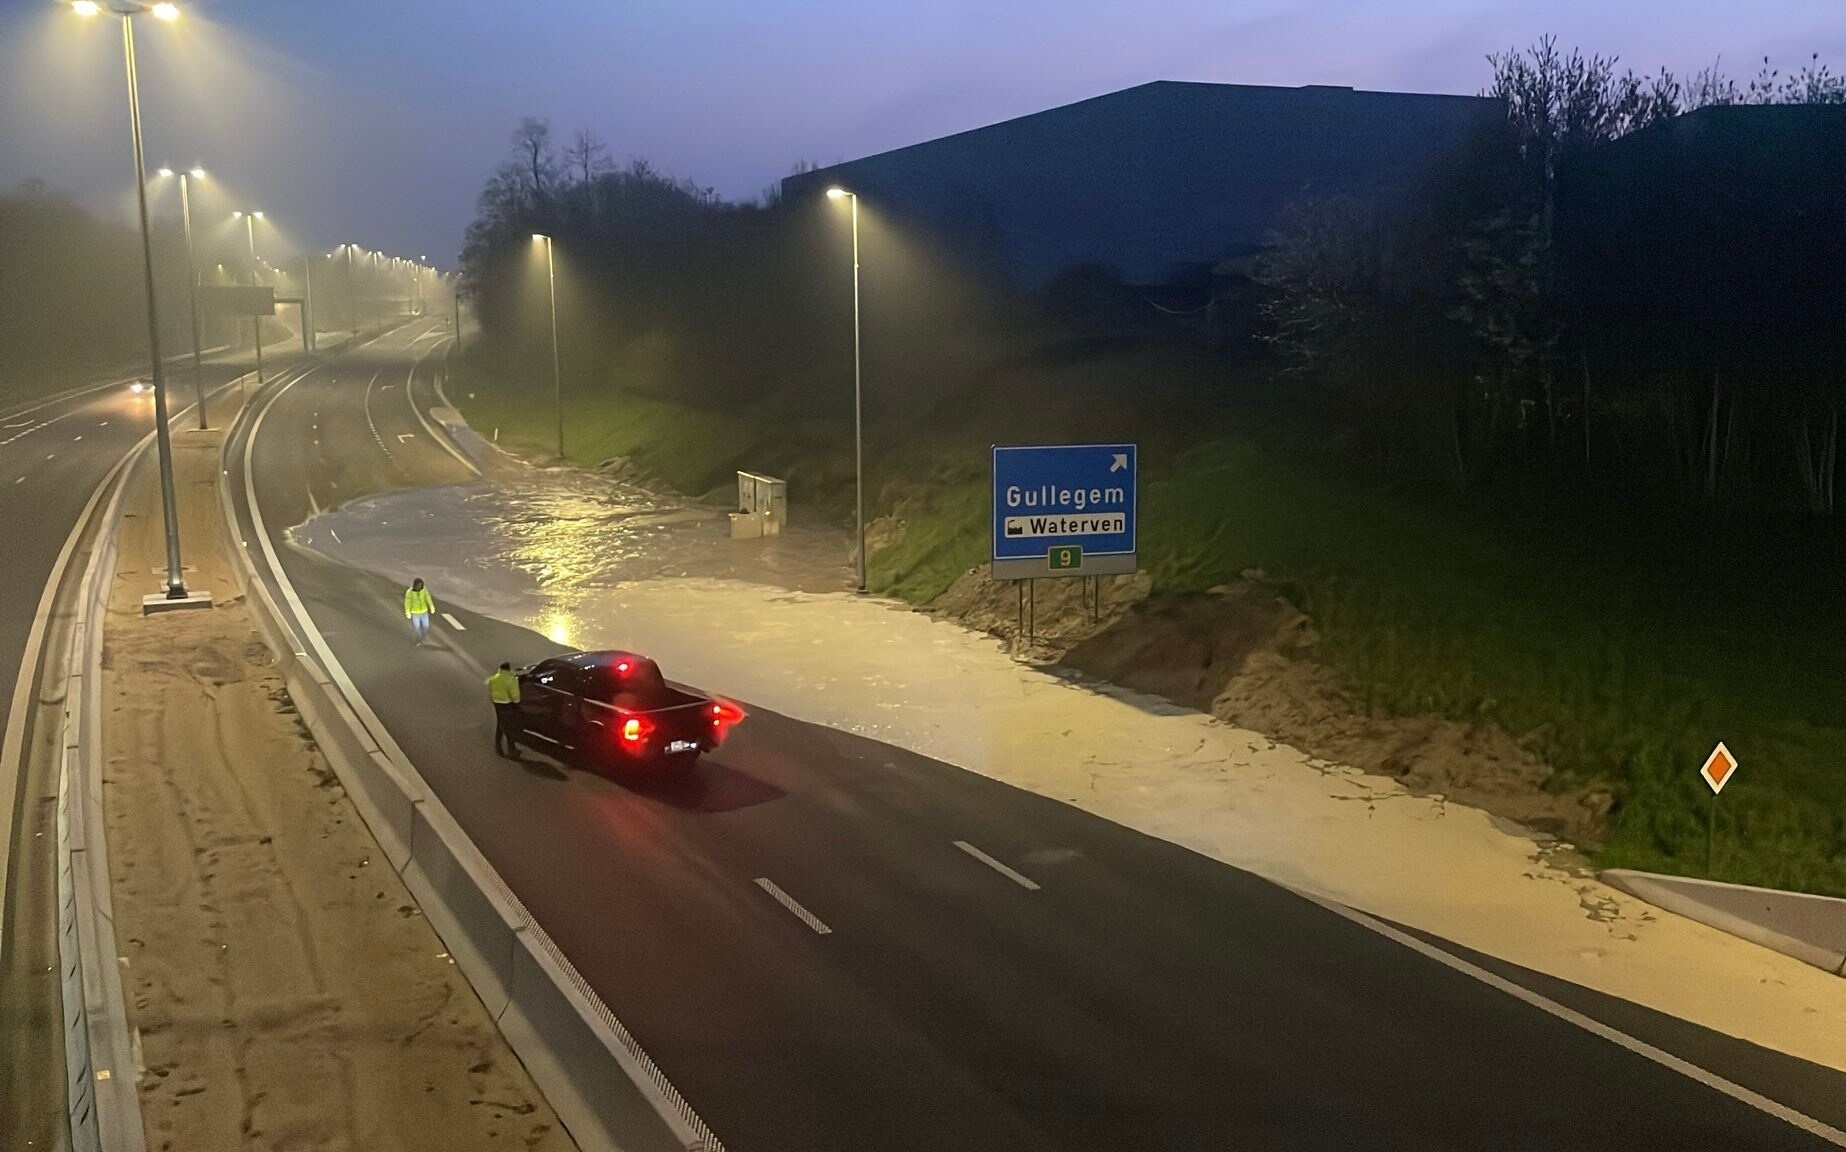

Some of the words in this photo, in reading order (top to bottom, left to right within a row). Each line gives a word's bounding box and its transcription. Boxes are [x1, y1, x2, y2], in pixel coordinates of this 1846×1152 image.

[1007, 485, 1124, 510] Gullegem
[1030, 517, 1123, 535] Waterven
[1060, 549, 1072, 566] 9
